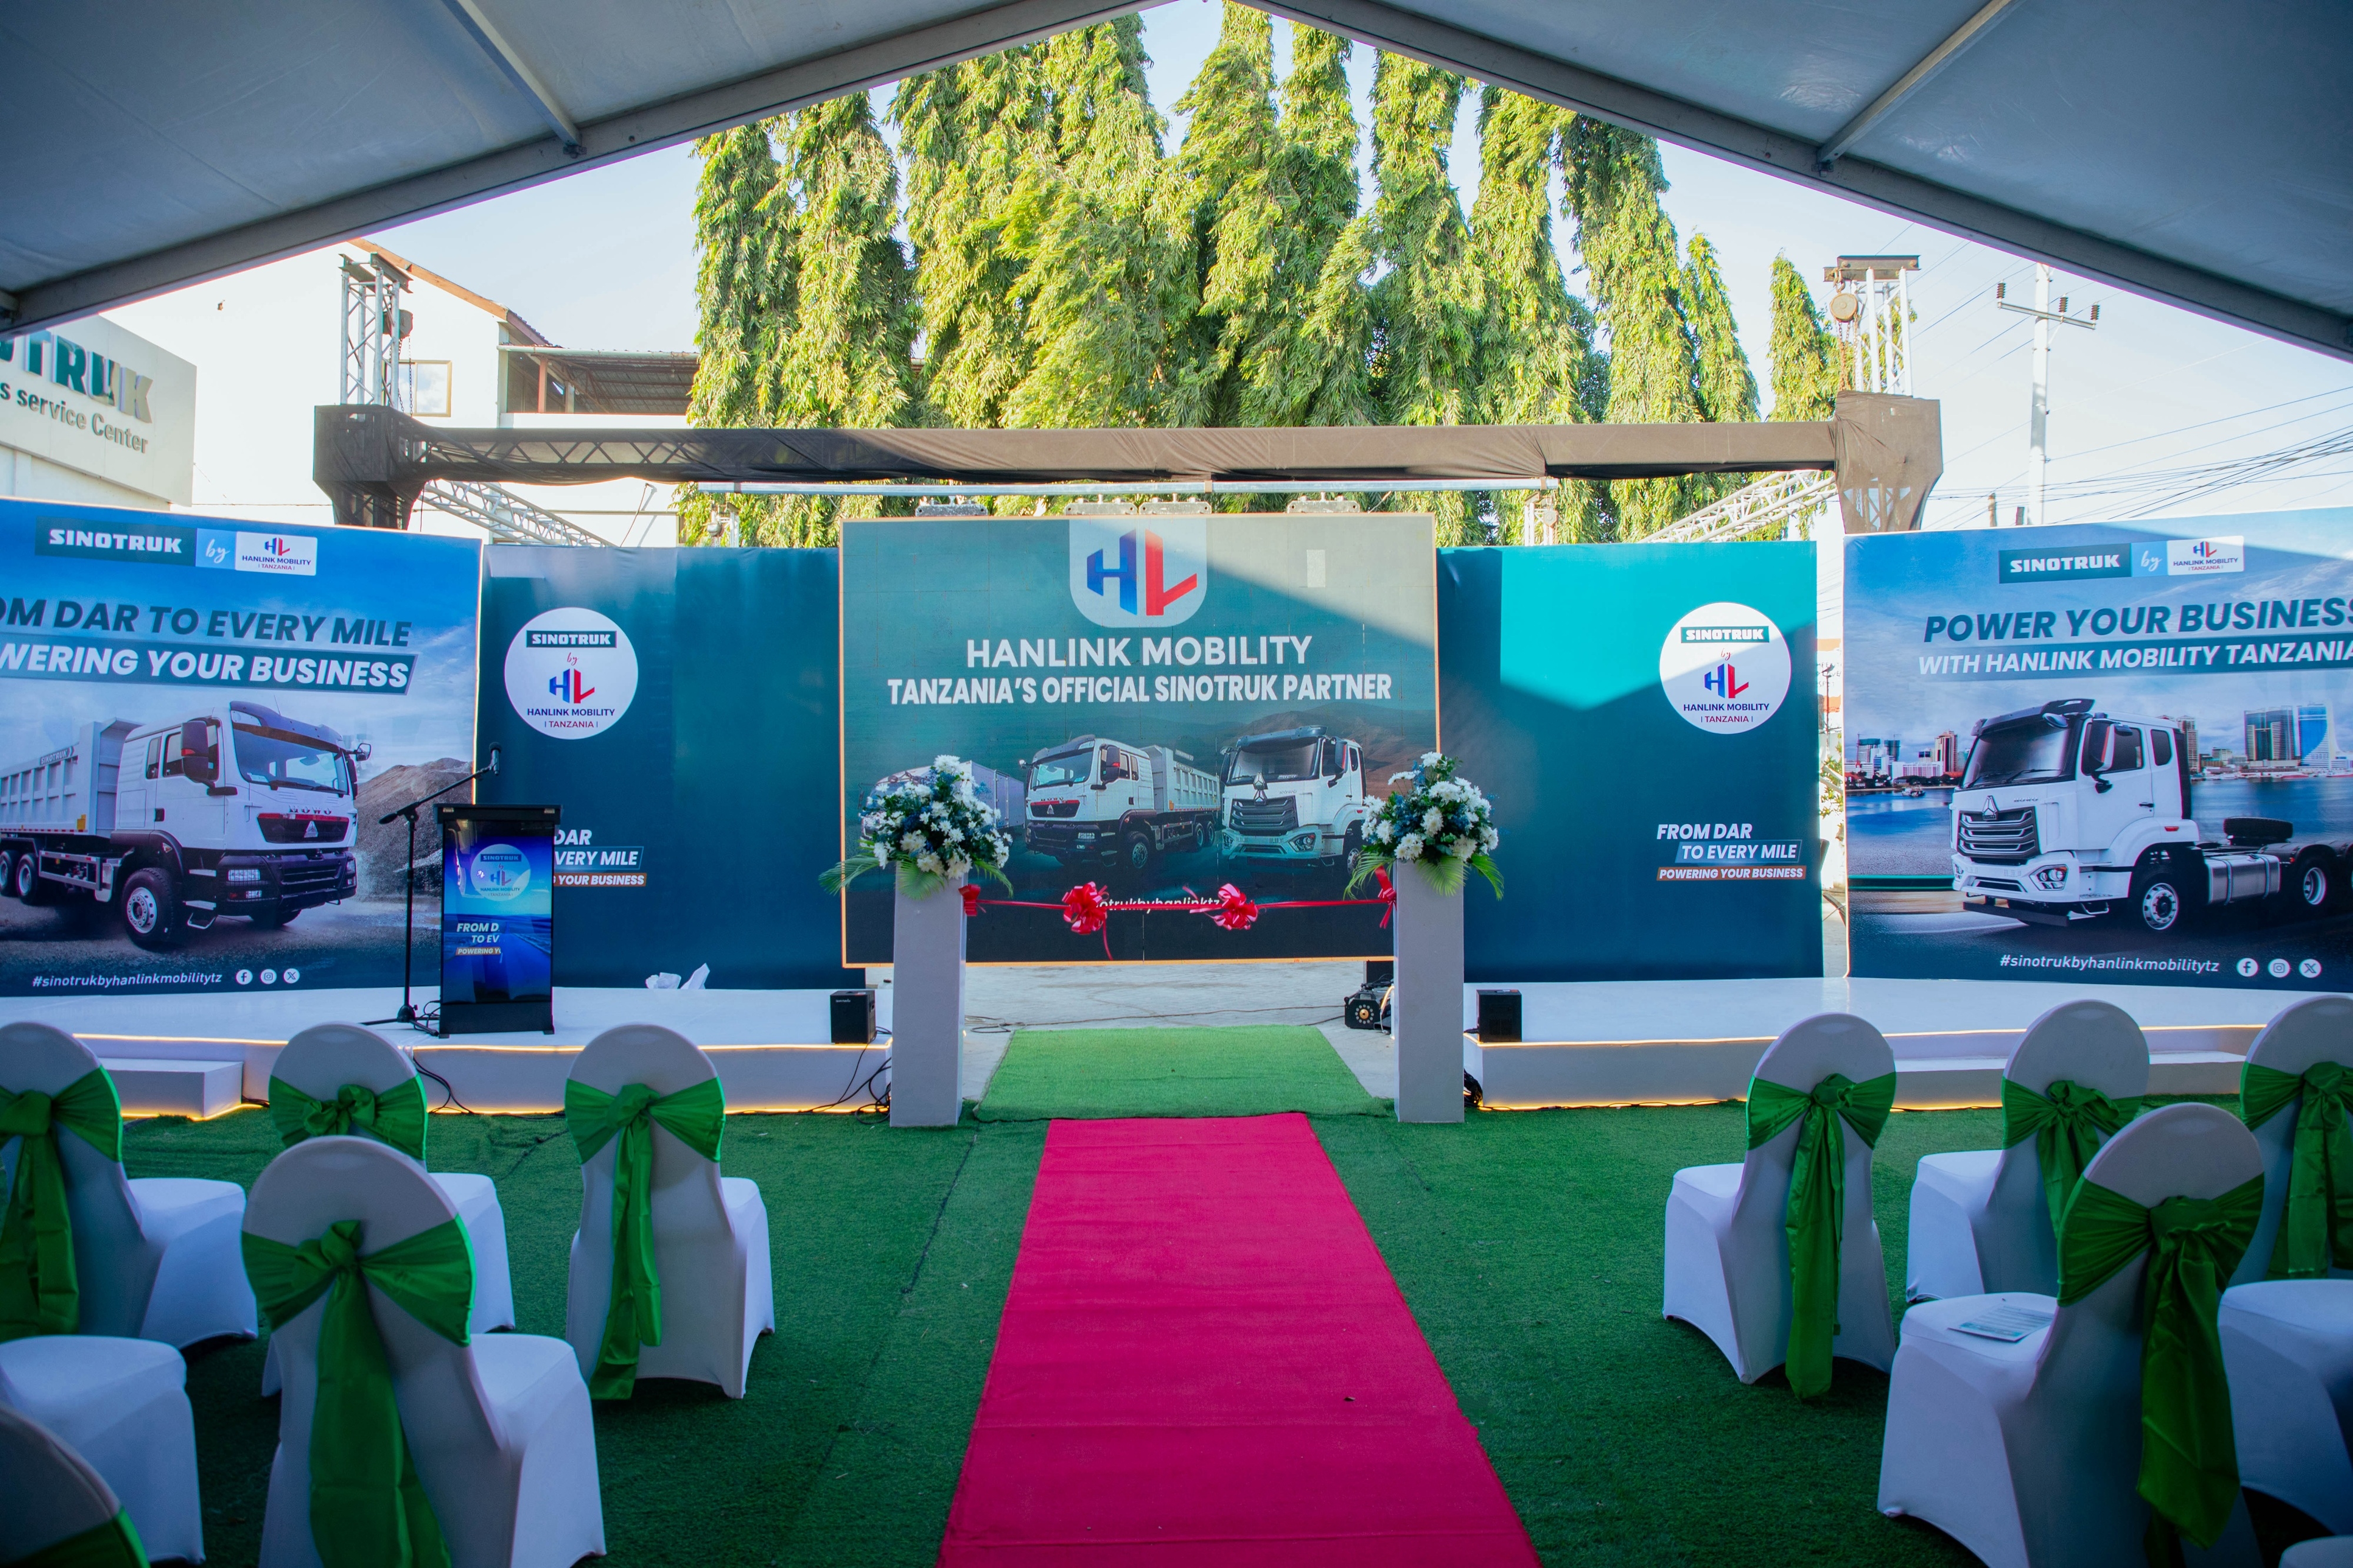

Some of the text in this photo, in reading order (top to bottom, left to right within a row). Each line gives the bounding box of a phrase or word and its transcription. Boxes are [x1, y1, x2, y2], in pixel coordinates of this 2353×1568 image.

[17, 389, 87, 430] service
[92, 413, 148, 453] Center
[49, 529, 230, 563] SINOTRUK by
[2009, 550, 2163, 573] SINOTRUK by
[53, 600, 140, 632] DAR
[149, 606, 199, 635] TO
[206, 610, 326, 642] EVERY
[331, 618, 412, 646] MILE
[1924, 597, 2353, 642] POWER YOUR BUSINES
[532, 633, 611, 645] SINOTRUK
[1686, 629, 1764, 640] SINOTRUK
[566, 652, 579, 666] by
[967, 635, 1312, 668] HANLINK MOBILITY
[1720, 648, 1731, 661] by
[1918, 654, 1981, 675] WITH
[1985, 650, 2095, 673] HANLINK
[2099, 646, 2221, 669] MOBILITY
[147, 650, 245, 680] YOUR
[249, 656, 409, 688] BUSINESS
[887, 673, 1392, 705] TANZANIA'S OFFICIAL SINOTRUK PARTNER
[1657, 823, 1753, 840] FROM DAR
[600, 851, 638, 865] MILE
[1682, 844, 1798, 859] TO EVERY MILE
[558, 875, 590, 885] YOUR
[591, 875, 644, 885] BUSINESS
[1659, 868, 1804, 879] POWERING YOUR BUSINESS
[456, 923, 489, 932] FROM
[471, 935, 485, 943] TO
[2000, 954, 2219, 974] #sinotrukbyhanlinkmobilitytz
[32, 972, 222, 988] #sinotrukbyhanlinkmobilitytz
